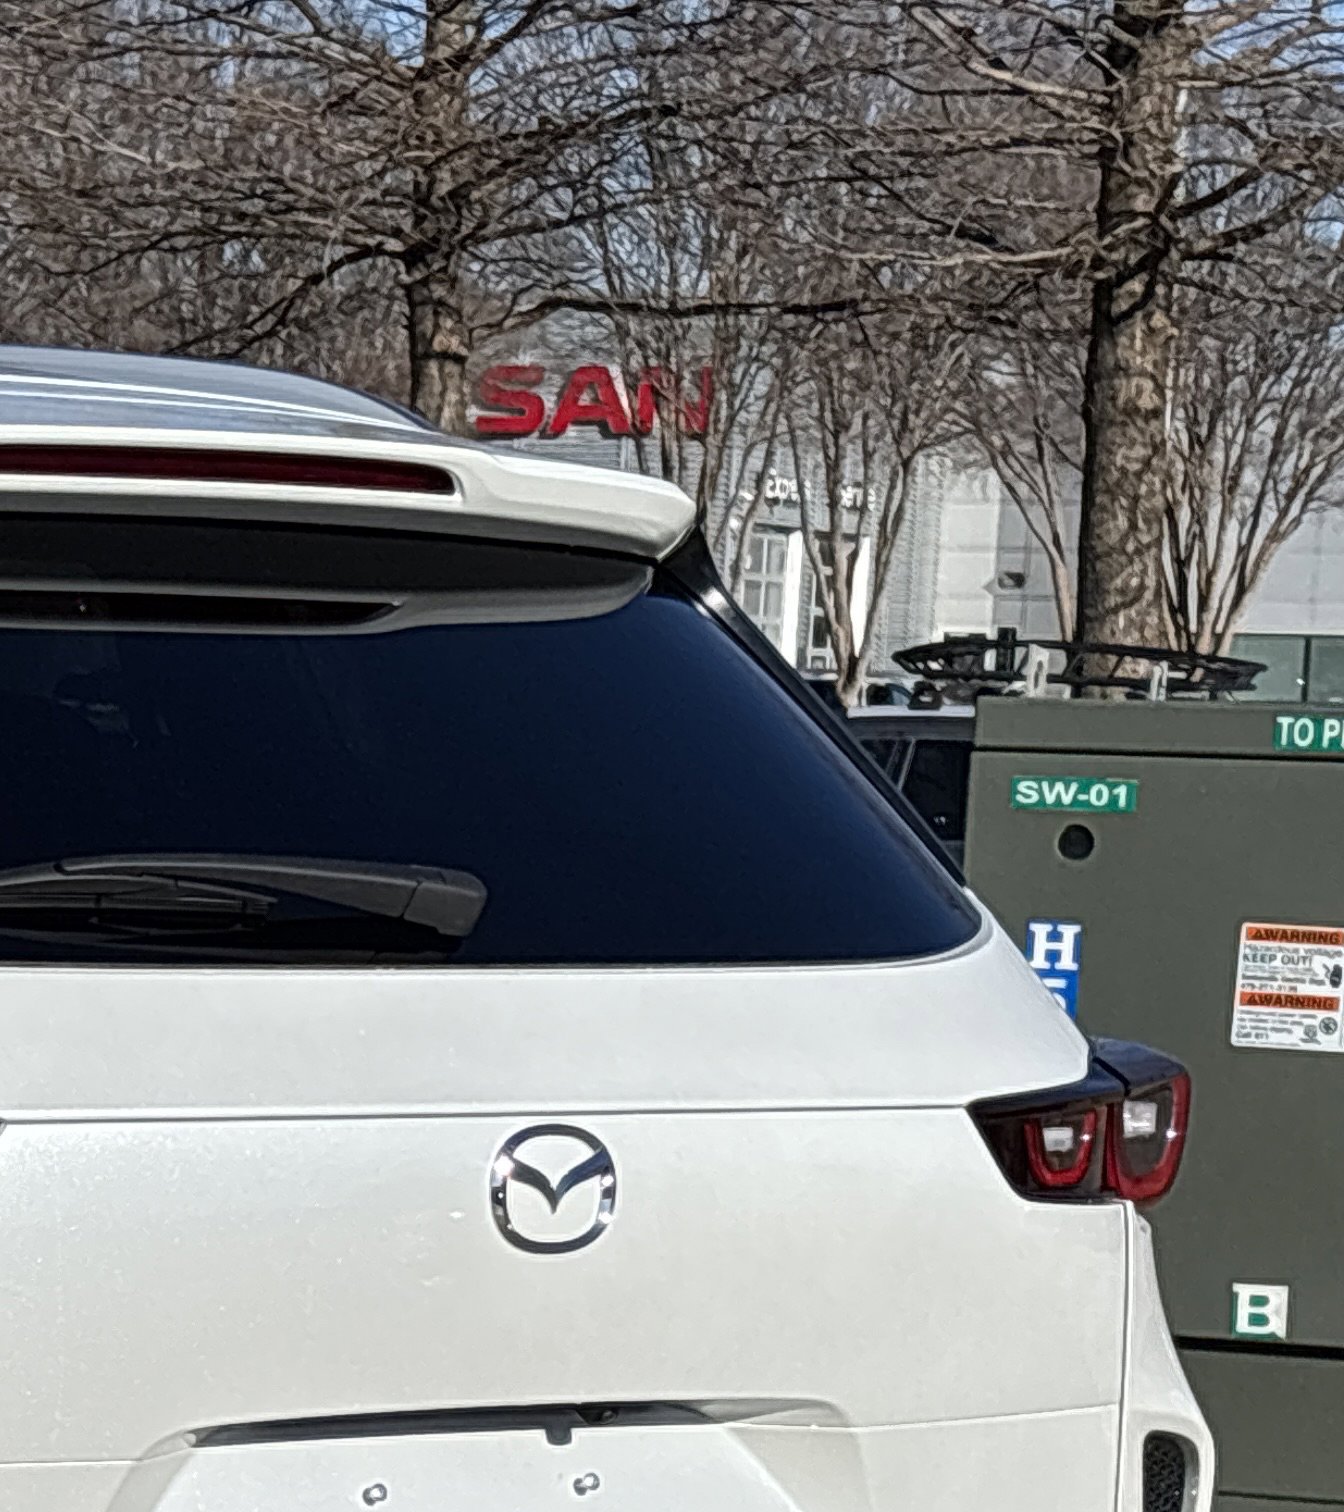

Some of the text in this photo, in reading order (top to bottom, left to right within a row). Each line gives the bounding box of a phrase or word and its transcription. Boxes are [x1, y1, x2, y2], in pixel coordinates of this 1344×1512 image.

[1275, 716, 1344, 749] TO P
[1015, 780, 1128, 809] SW-01
[1028, 922, 1082, 971] H
[1262, 927, 1340, 945] WARNING
[1242, 953, 1277, 964] KEEP
[1258, 992, 1334, 1010] WARNING
[1233, 1282, 1282, 1336] B
